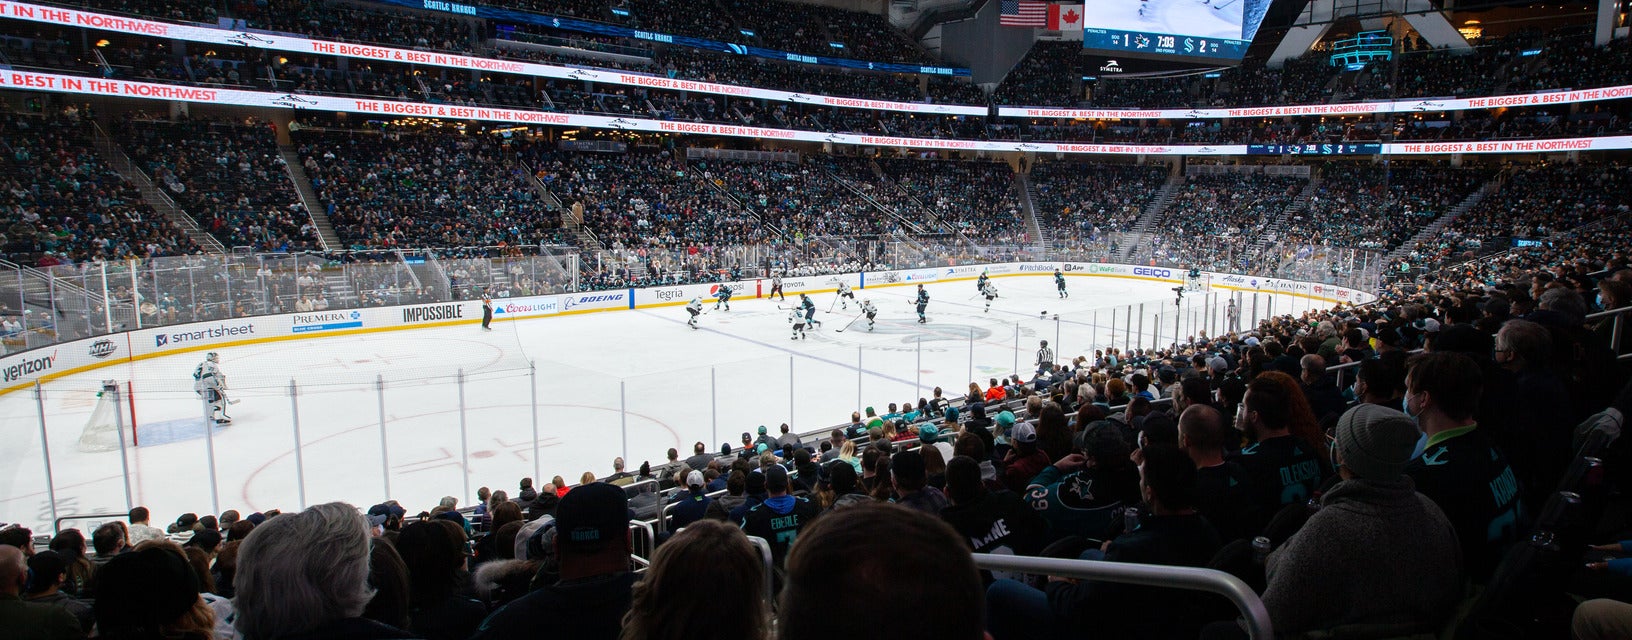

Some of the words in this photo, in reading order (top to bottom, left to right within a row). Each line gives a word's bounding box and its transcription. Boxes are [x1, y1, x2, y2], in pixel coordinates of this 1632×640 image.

[14, 5, 34, 18] IN
[40, 9, 71, 22] THE
[77, 14, 168, 35] NORTHWEST
[1124, 34, 1129, 46] 1
[1158, 36, 1174, 48] 7:03
[1200, 40, 1205, 52] 2
[312, 42, 335, 53] THE
[340, 46, 390, 59] BIGGEST
[394, 51, 403, 60] &
[407, 53, 431, 63] BEST
[435, 56, 447, 64] IN
[450, 57, 468, 66] THE
[471, 59, 524, 72] NORTHWEST
[13, 74, 54, 88] BEST
[62, 79, 82, 90] IN
[88, 81, 118, 93] THE
[124, 84, 216, 100] NORTHWEST
[621, 76, 635, 84] THE
[638, 78, 670, 87] BIGGEST
[1469, 99, 1486, 107] THE
[1488, 96, 1528, 106] BIGGEST
[1543, 94, 1566, 102] BEST
[1569, 92, 1579, 100] IN
[1583, 90, 1599, 99] THE
[356, 101, 378, 111] THE
[384, 104, 433, 115] BIGGEST
[438, 107, 446, 115] &
[451, 107, 474, 117] BEST
[478, 110, 490, 118] IN
[493, 111, 511, 120] THE
[514, 112, 569, 123] NORTHWEST
[660, 122, 674, 130] THE
[678, 124, 709, 132] BIGGEST
[1338, 145, 1342, 153] 2
[1536, 140, 1592, 149] NORTHWEST
[1134, 267, 1170, 278] GEICO
[1223, 275, 1245, 283] Alaska
[579, 293, 624, 303] BOEING
[655, 288, 683, 301] Tegria
[403, 304, 462, 322] IMPOSSIBLE
[506, 303, 532, 314] Coors
[532, 302, 556, 313] LIGHT
[293, 311, 345, 325] PREMERA
[172, 323, 255, 343] smartsheet
[3, 355, 51, 382] verizon
[771, 514, 798, 530] EBERLE
[970, 518, 1010, 550] KANE
